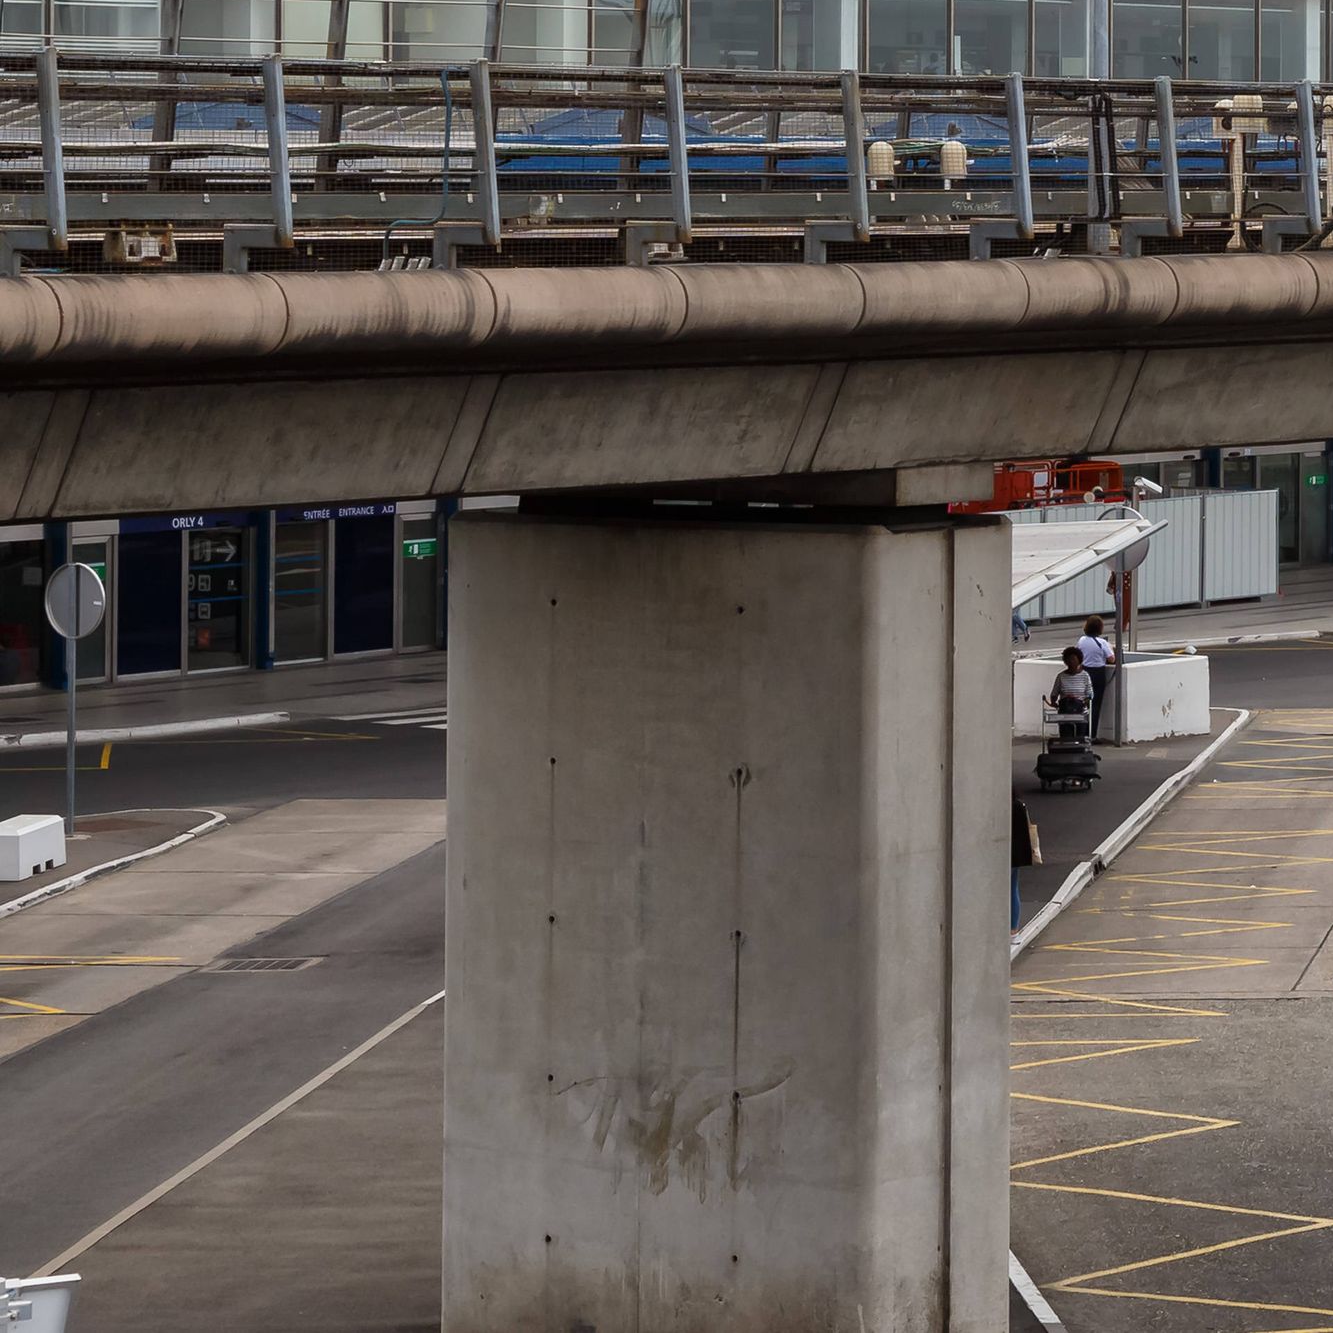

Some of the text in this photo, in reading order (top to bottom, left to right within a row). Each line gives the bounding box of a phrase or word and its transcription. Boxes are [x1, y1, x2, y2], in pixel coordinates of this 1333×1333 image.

[303, 505, 375, 520] ENTRÉE ENTRANCE
[172, 515, 204, 529] ORLY 4
